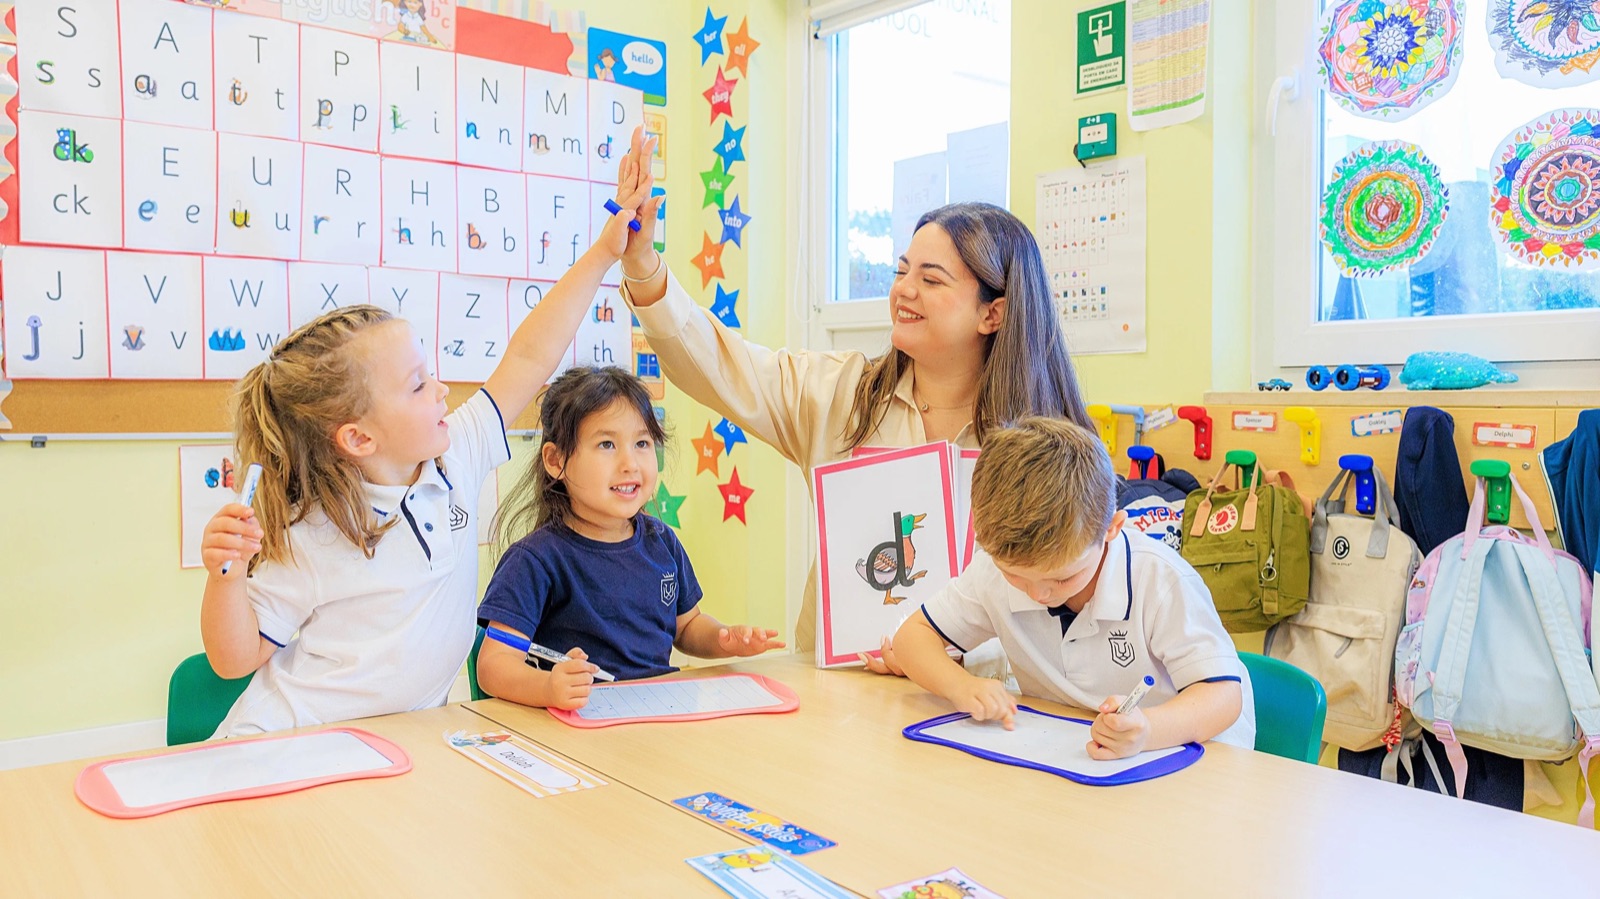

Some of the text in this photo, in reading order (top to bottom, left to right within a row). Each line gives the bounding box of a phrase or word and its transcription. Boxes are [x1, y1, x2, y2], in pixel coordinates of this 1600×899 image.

[58, 7, 77, 37] S
[154, 22, 179, 52] A
[704, 31, 717, 44] her
[249, 35, 267, 63] T
[631, 51, 654, 65] hello
[734, 44, 746, 56] all
[335, 51, 349, 76] P
[88, 68, 101, 87] s
[181, 81, 199, 100] a
[276, 89, 284, 110] t
[482, 78, 497, 103] N
[711, 89, 729, 104] they
[546, 90, 566, 115] M
[613, 101, 624, 124] D
[353, 105, 366, 131] p
[435, 111, 439, 133] i
[53, 130, 92, 163] ck
[500, 129, 511, 145] n
[563, 138, 582, 155] m
[725, 138, 736, 153] no
[163, 147, 179, 177] E
[253, 157, 271, 186] U
[337, 169, 351, 196] R
[412, 180, 428, 206] H
[709, 178, 722, 190] she
[53, 185, 90, 215] ck
[485, 189, 499, 212] B
[555, 196, 564, 218] F
[186, 205, 200, 223] e
[276, 213, 290, 231] u
[724, 212, 742, 228] into
[358, 222, 365, 237] r
[432, 222, 445, 247] h
[504, 228, 515, 252] b
[563, 233, 580, 267] f
[47, 271, 61, 300] J
[144, 275, 166, 303] V
[230, 279, 263, 307] W
[322, 284, 341, 310] X
[524, 284, 542, 310] Q
[392, 286, 409, 313] Y
[466, 293, 480, 318] Z
[593, 301, 615, 323] th
[718, 305, 730, 318] we
[73, 322, 83, 359] j
[171, 332, 186, 349] v
[486, 342, 495, 357] z
[594, 340, 613, 362] th
[1494, 430, 1514, 438] Delphi
[728, 493, 741, 504] me
[866, 511, 915, 592] d
[500, 751, 533, 769] Delilah
[752, 823, 798, 842] Kids
